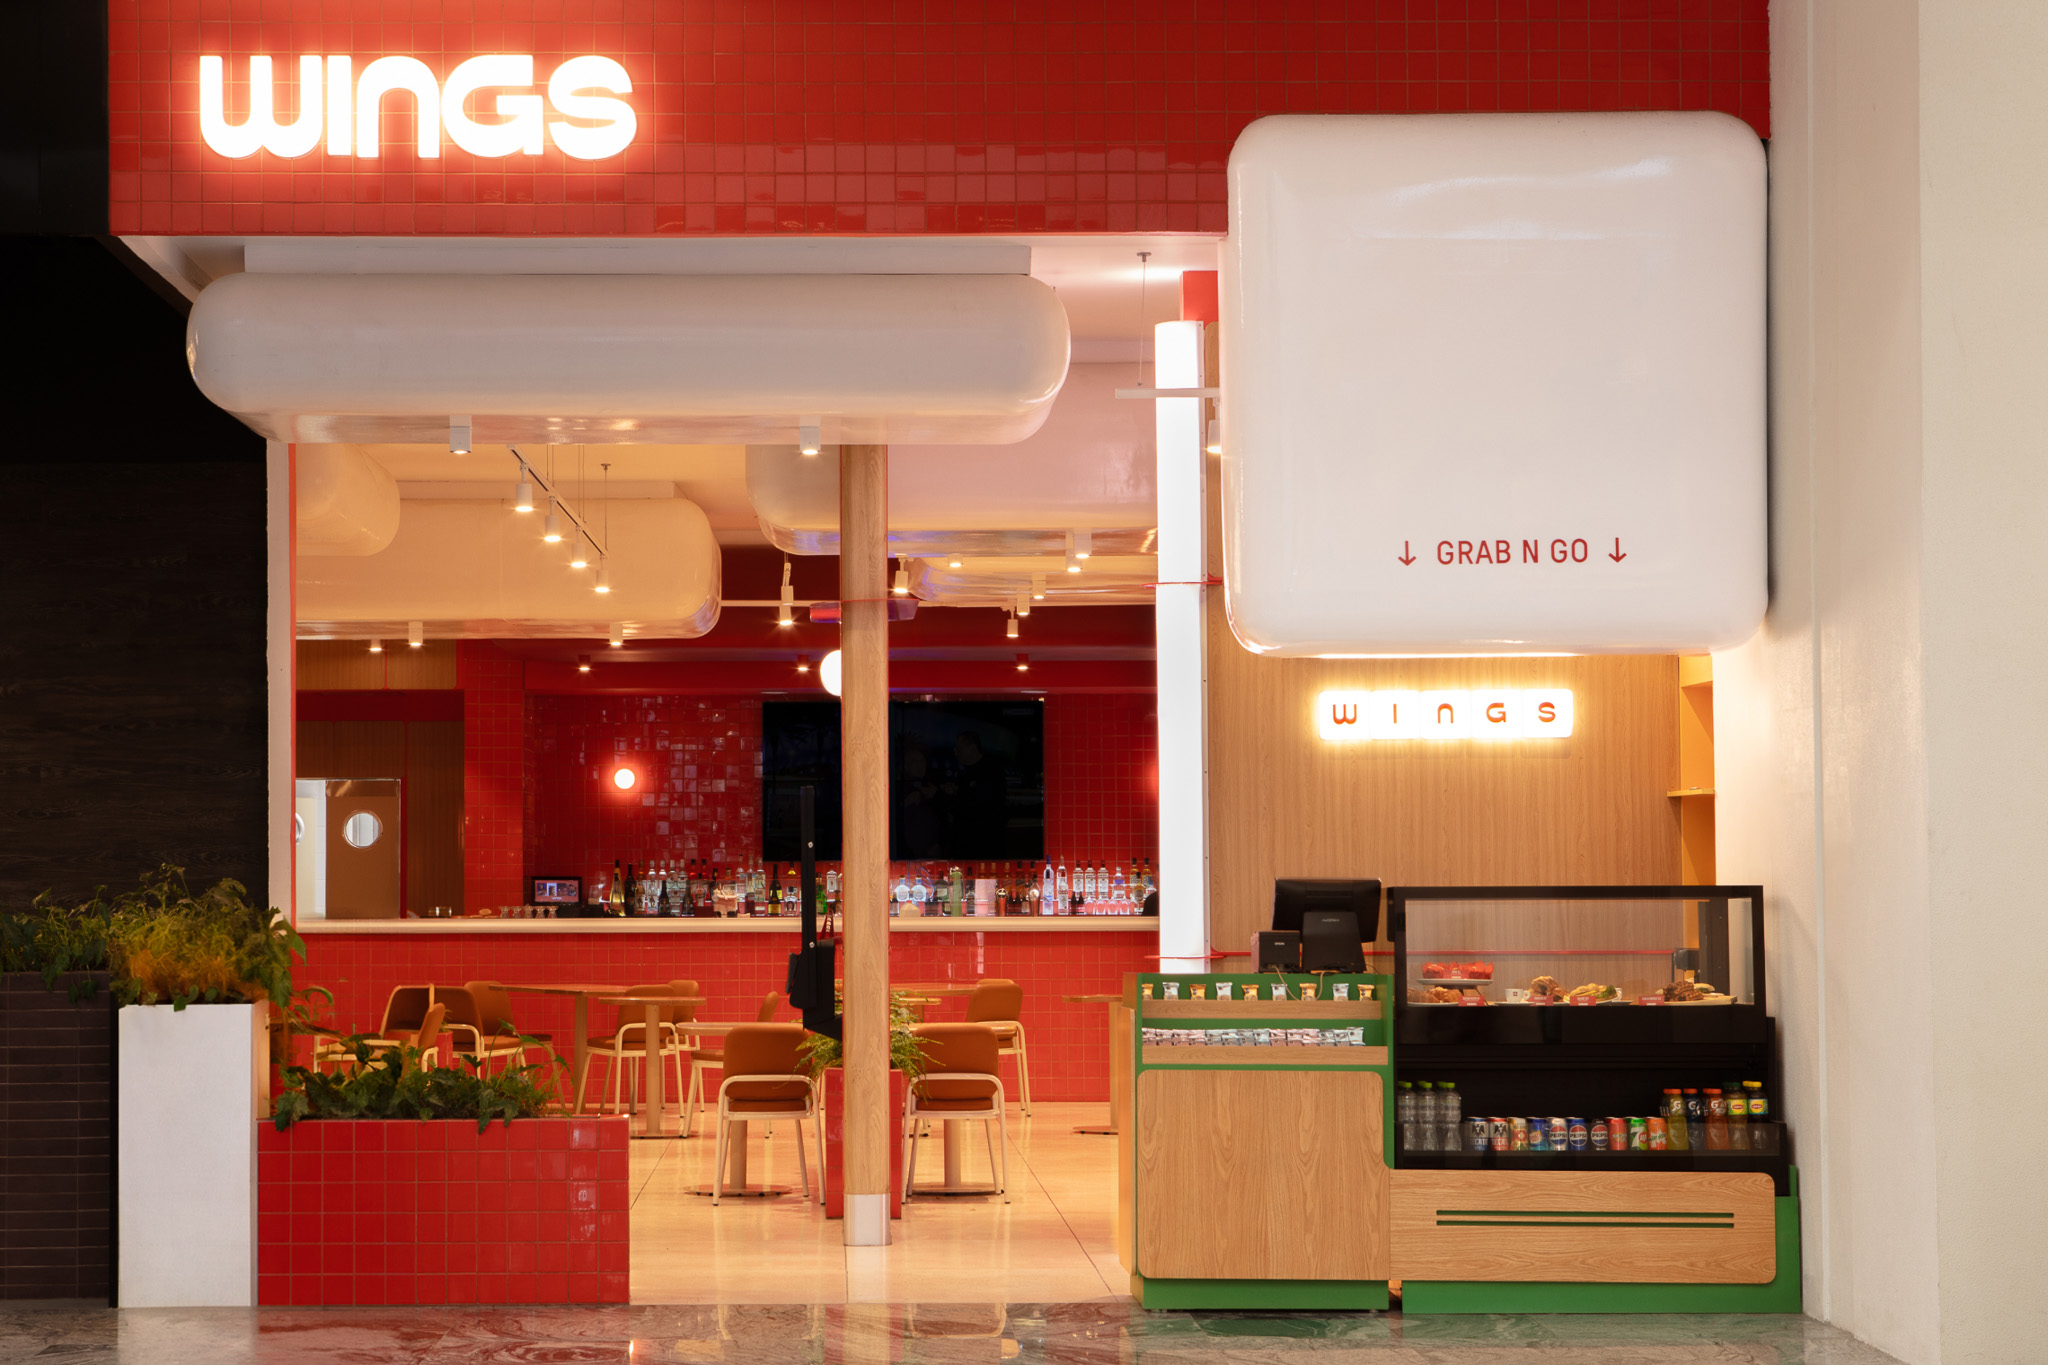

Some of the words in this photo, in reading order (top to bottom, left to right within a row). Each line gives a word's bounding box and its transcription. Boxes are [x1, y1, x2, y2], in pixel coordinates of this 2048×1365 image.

[199, 54, 638, 160] WINGS
[1437, 540, 1511, 565] GRAB
[1522, 539, 1539, 564] N
[1550, 538, 1588, 563] GO
